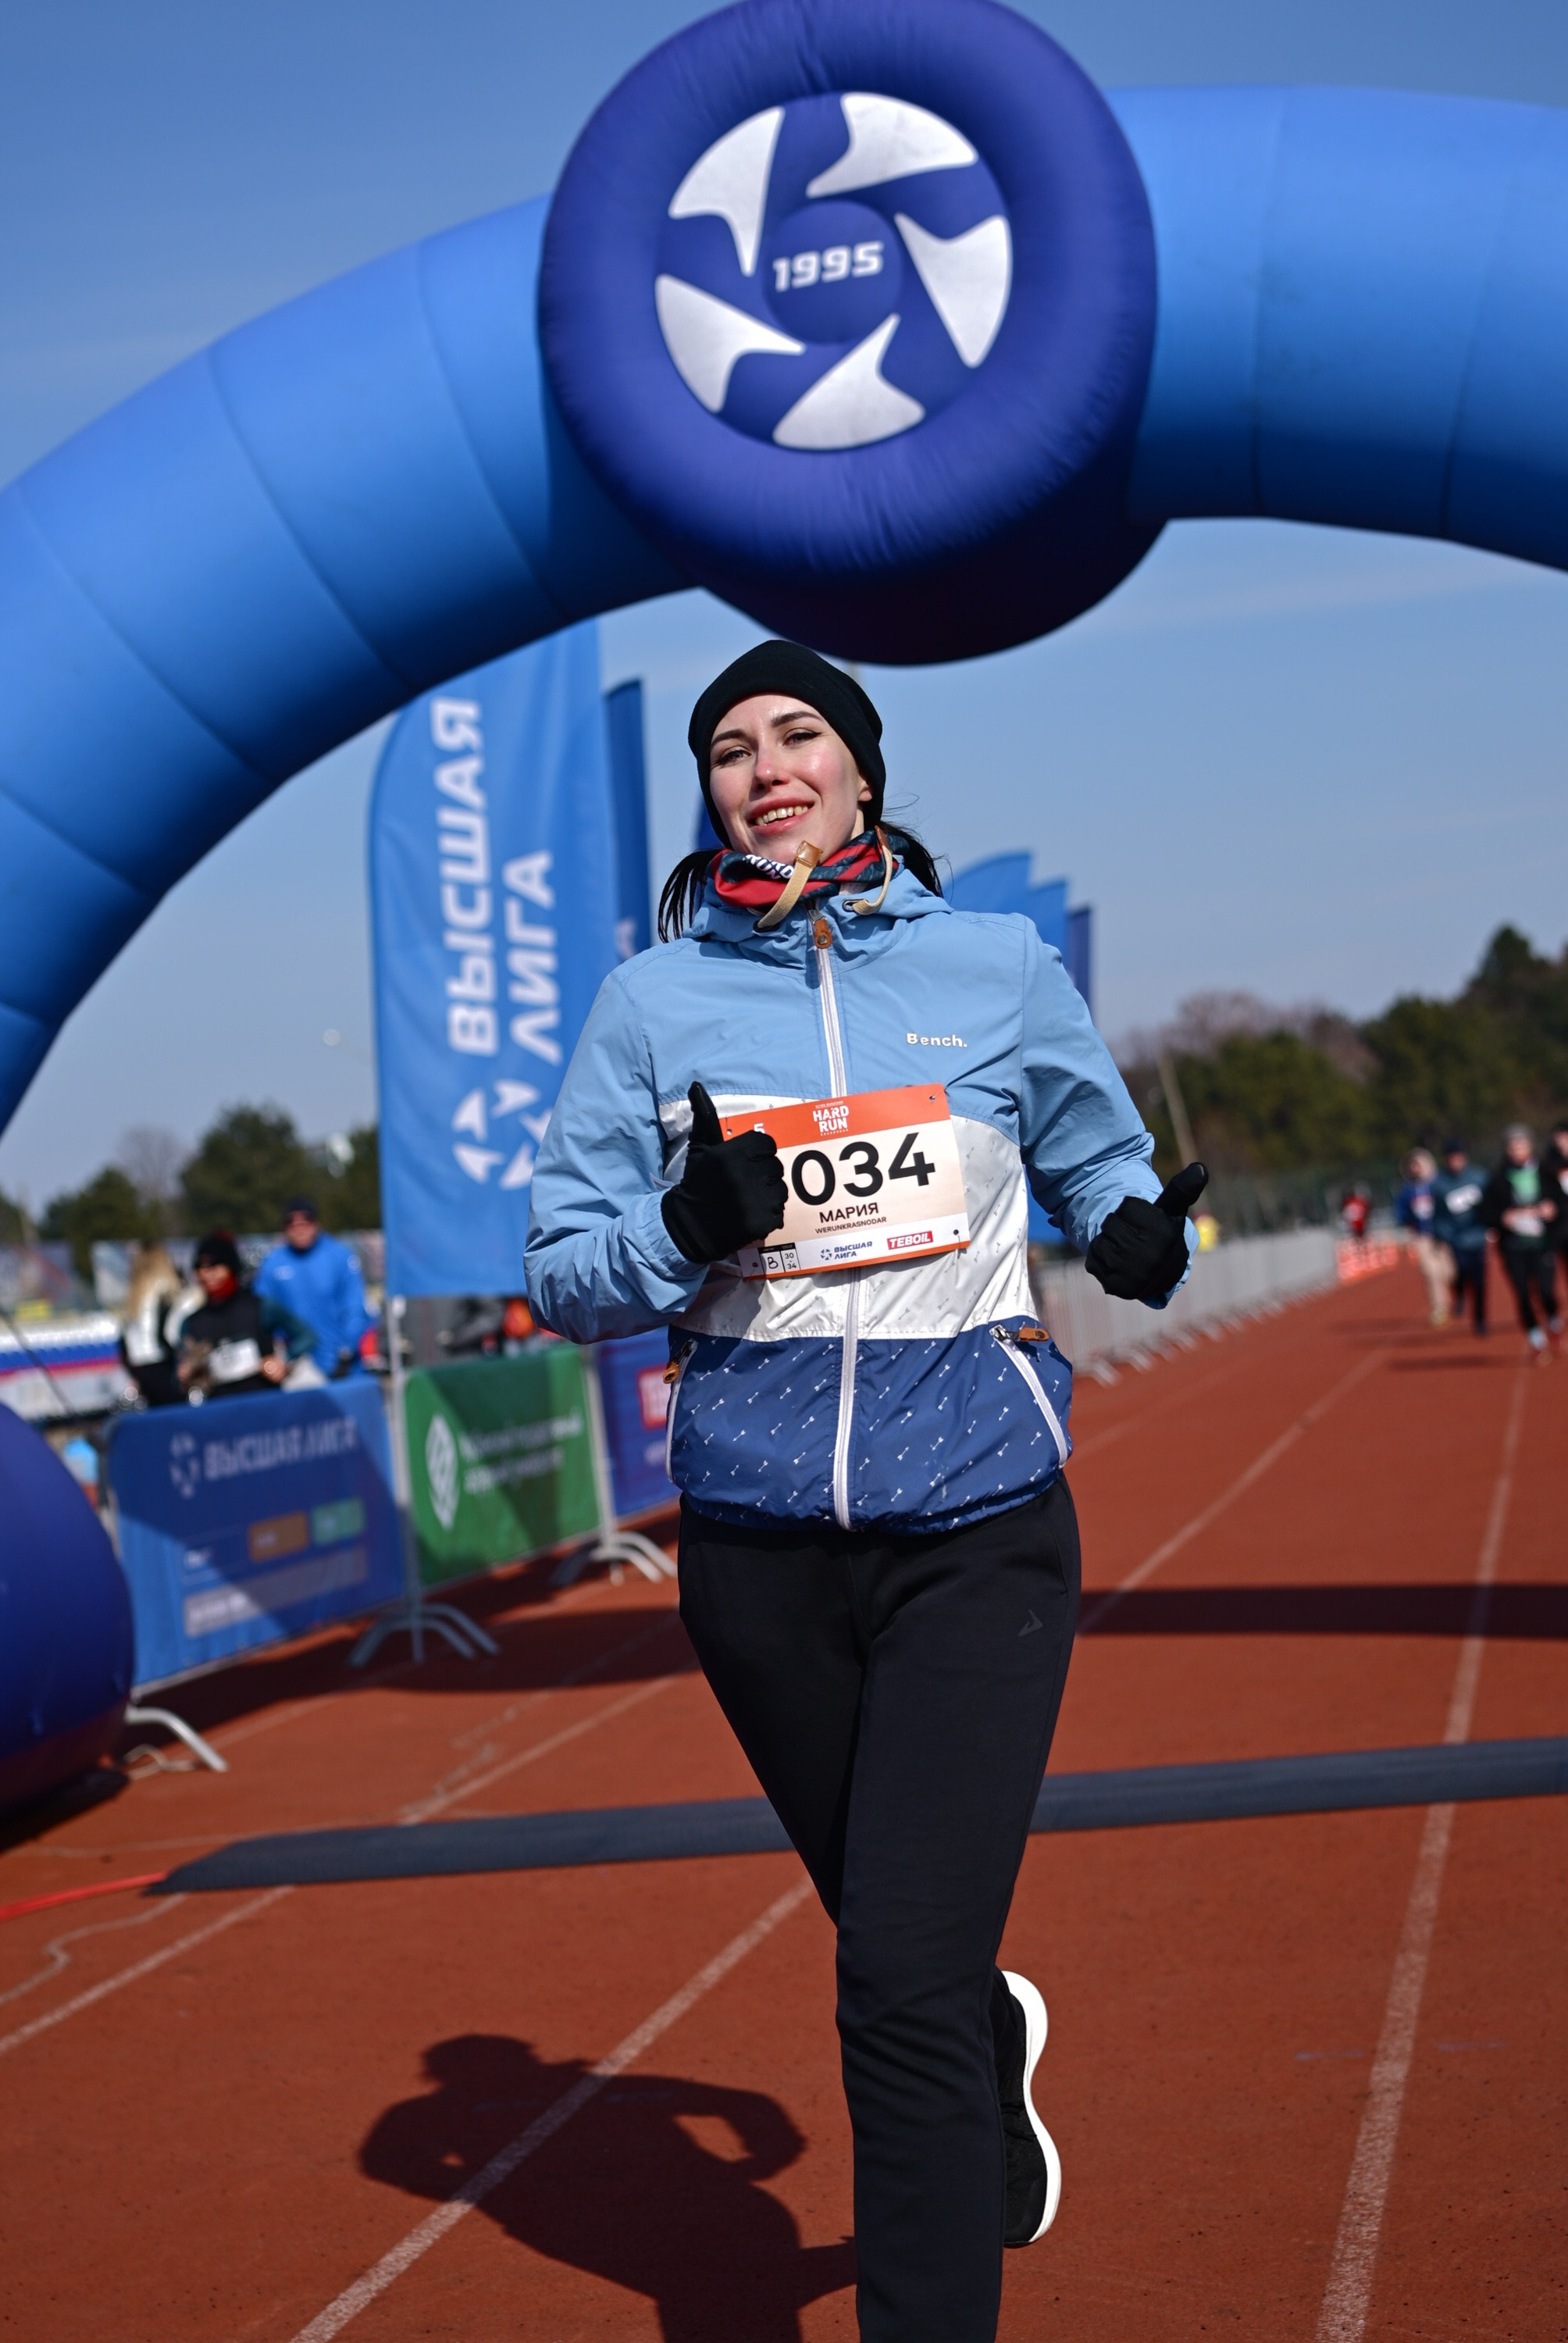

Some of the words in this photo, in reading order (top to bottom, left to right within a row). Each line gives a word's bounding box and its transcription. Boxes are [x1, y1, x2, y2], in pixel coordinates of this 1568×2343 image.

[773, 241, 883, 292] 1995
[430, 696, 499, 1057] ВЫСШАЯ
[502, 850, 563, 1065] ЛИГА
[907, 1033, 968, 1047] Bench.
[812, 1105, 849, 1122] HARD
[818, 1117, 848, 1132] RUN
[791, 1132, 935, 1206] 034
[819, 1202, 878, 1223] МАРИЯ
[814, 1216, 887, 1234] WERUNKRASNODAR
[834, 1241, 873, 1253] ВЫСШАЯ
[889, 1232, 932, 1249] TEBOIL
[834, 1251, 857, 1260] ЛИГА
